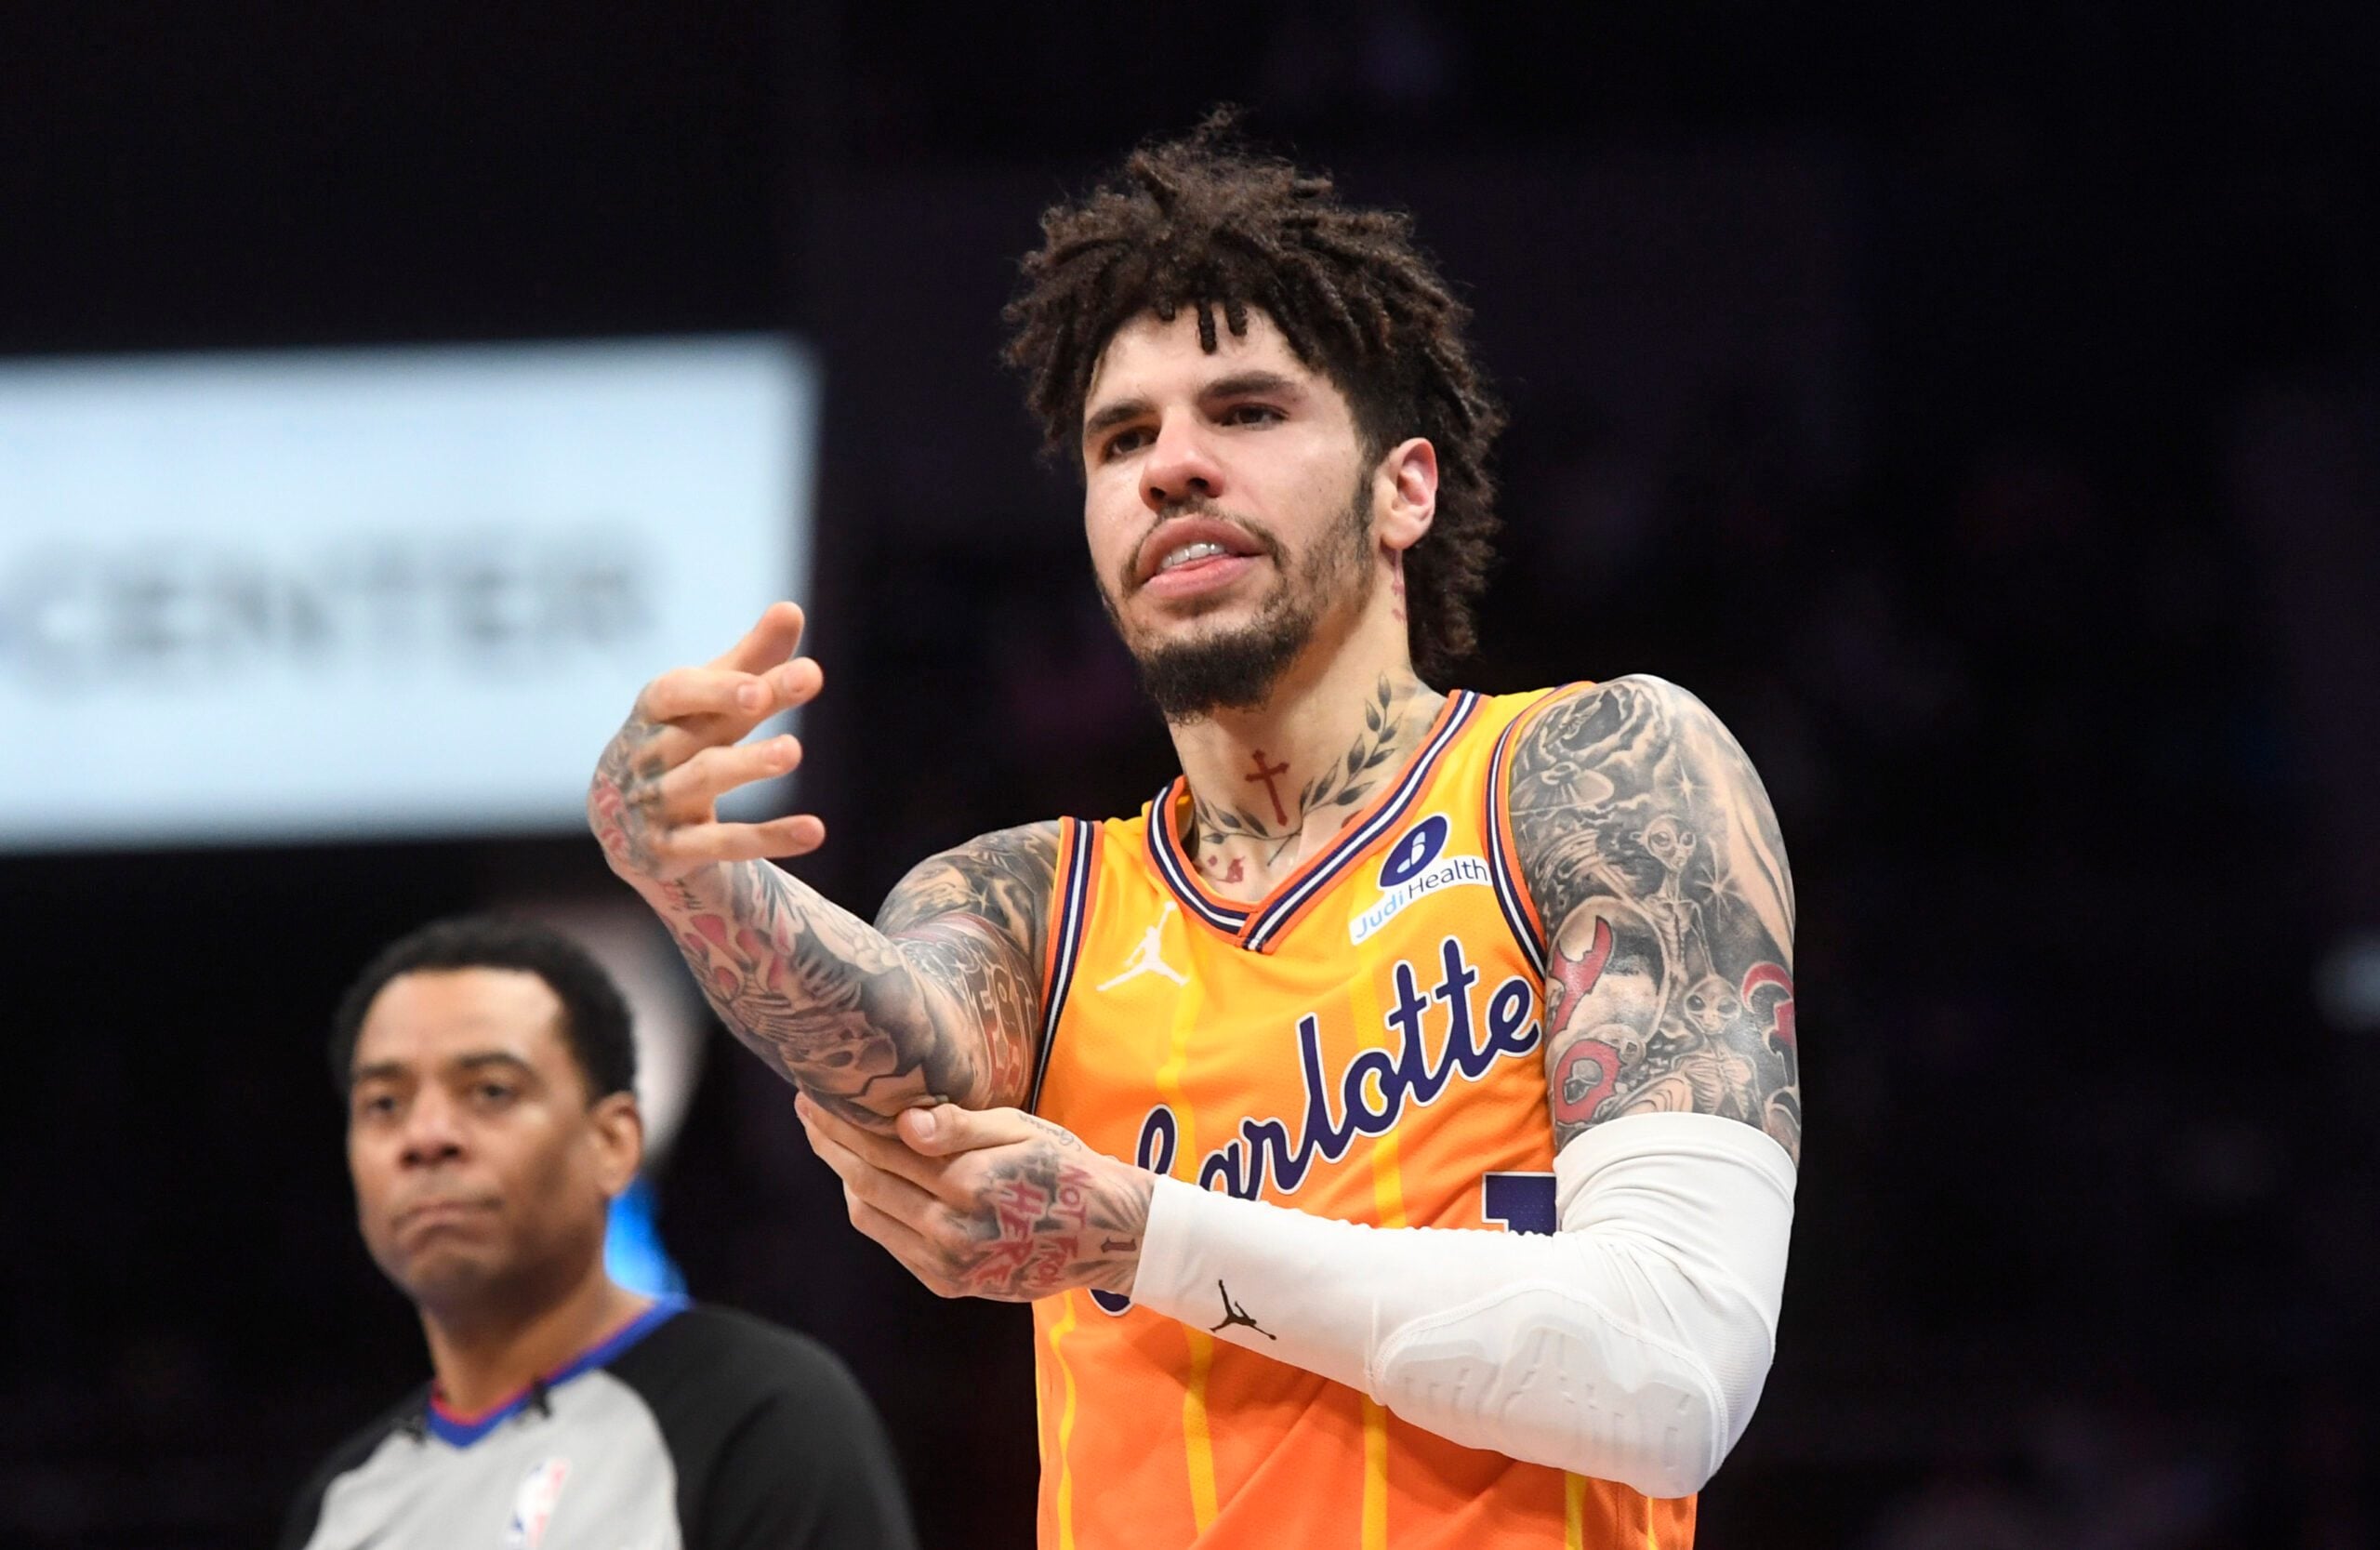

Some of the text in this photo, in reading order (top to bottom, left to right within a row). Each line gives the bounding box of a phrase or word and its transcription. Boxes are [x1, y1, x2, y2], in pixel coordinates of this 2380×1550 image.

[5, 525, 655, 686] CENTER
[959, 1180, 1046, 1286] HERE
[1051, 1164, 1094, 1229] NOT
